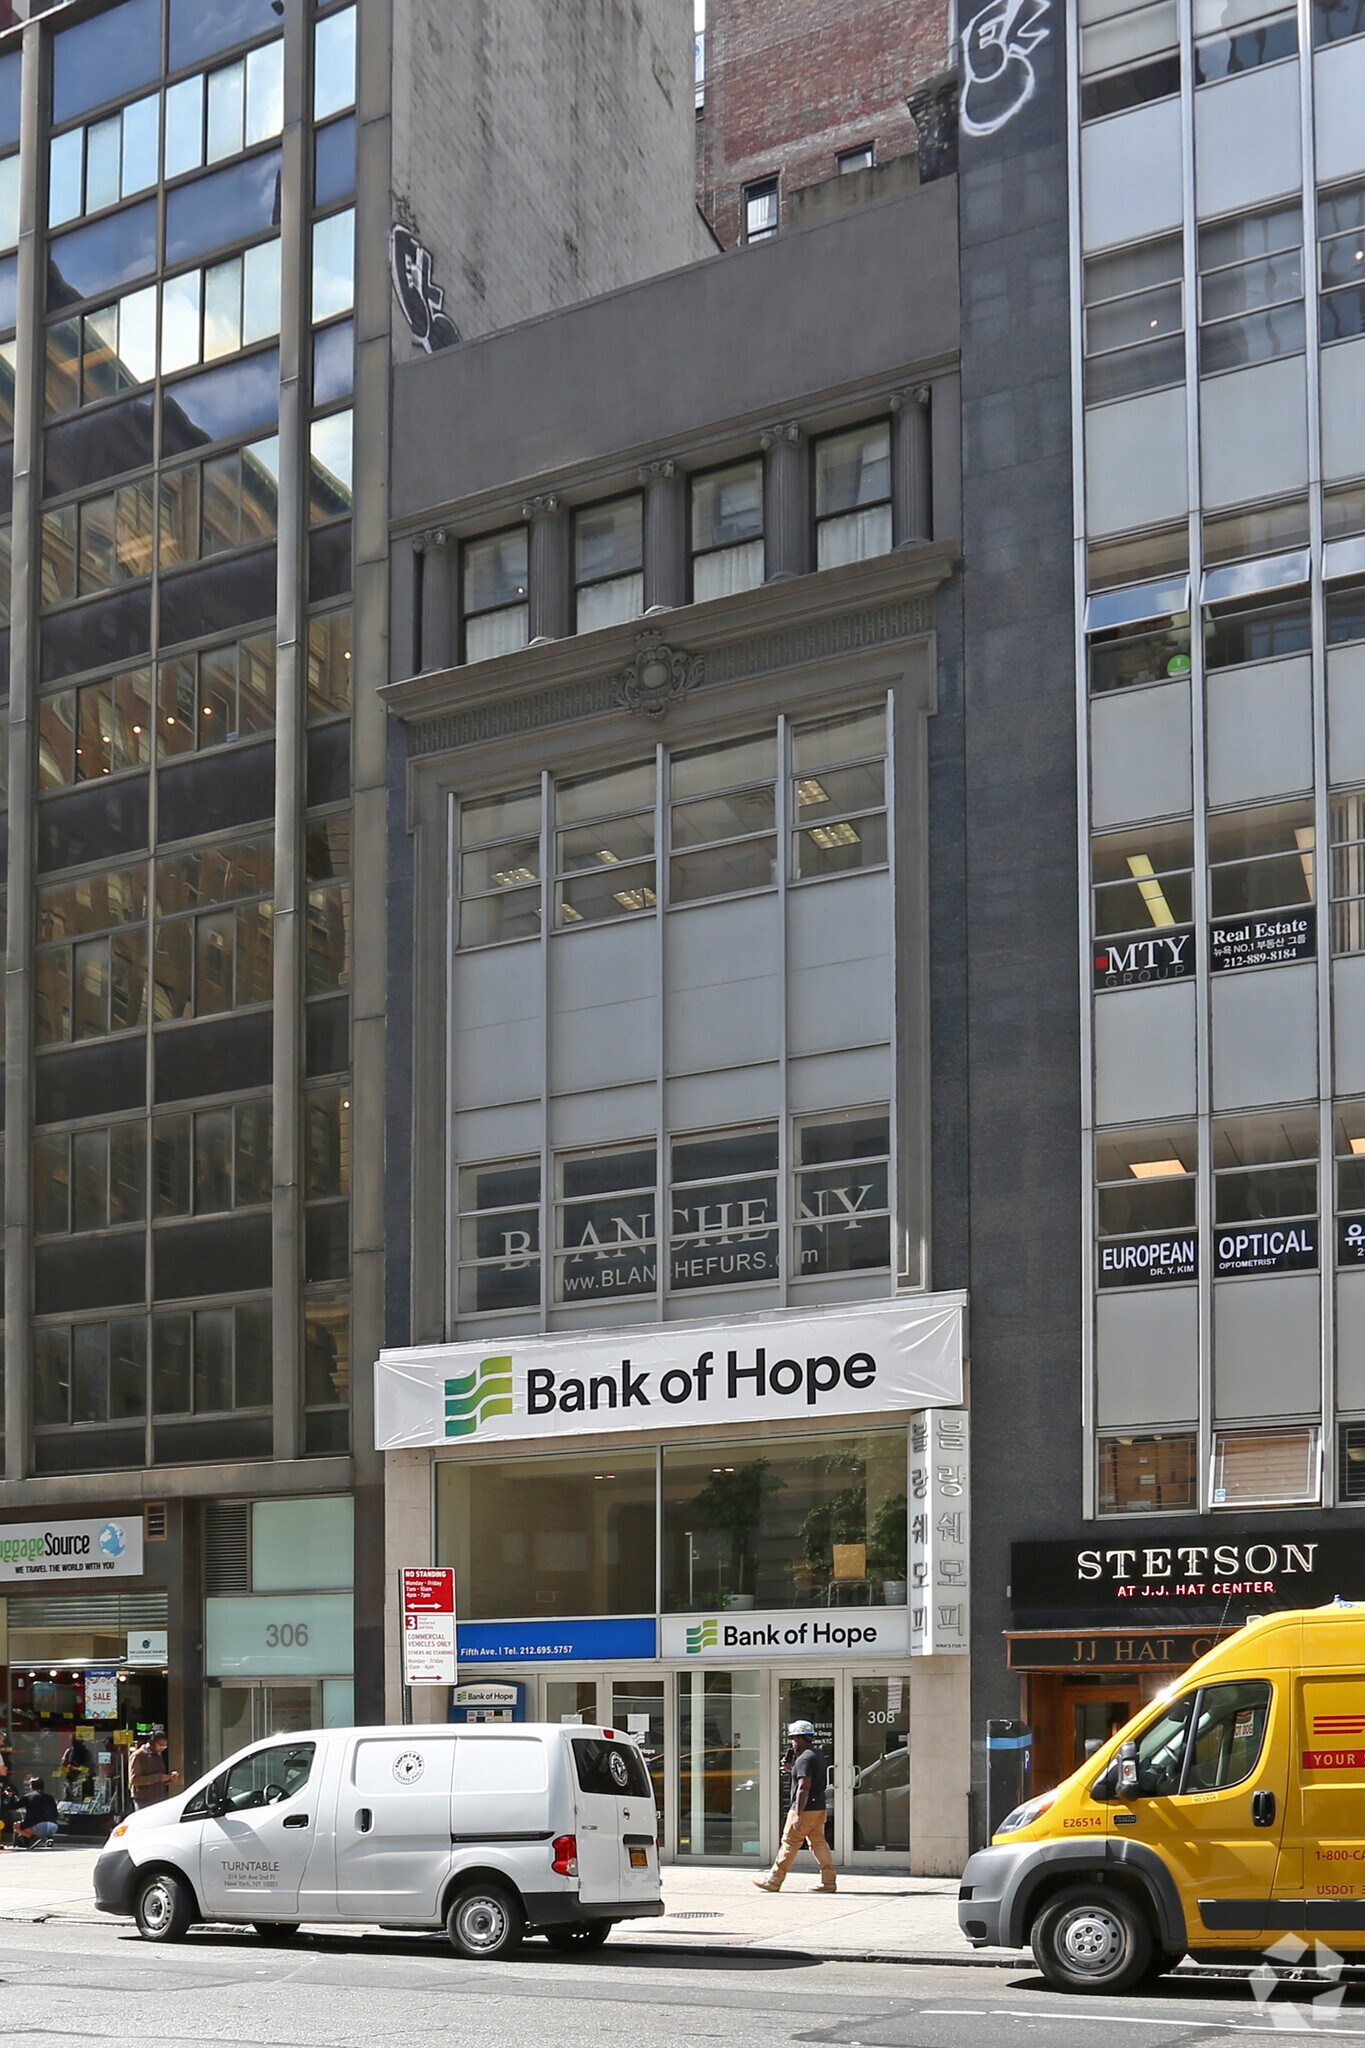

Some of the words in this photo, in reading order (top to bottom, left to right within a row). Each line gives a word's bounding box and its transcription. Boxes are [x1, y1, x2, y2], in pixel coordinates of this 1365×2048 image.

[1213, 926, 1250, 945] Real
[1255, 919, 1307, 938] Estate
[1105, 935, 1189, 974] MTY
[1233, 943, 1254, 953] NO.1
[1223, 948, 1296, 968] 212-889-8184
[1105, 964, 1185, 987] GROUP
[500, 1198, 770, 1271] BANHE
[1103, 1240, 1194, 1270] EUROPEAN
[1219, 1229, 1313, 1260] OPTICAL
[1150, 1267, 1166, 1276] DR.
[1167, 1267, 1175, 1275] Y.
[1177, 1265, 1194, 1274] KIM
[1219, 1258, 1277, 1270] OPTOMETRIST
[527, 1359, 651, 1415] Bank
[660, 1351, 713, 1404] of
[727, 1347, 876, 1405] Hope
[0, 1532, 90, 1562] ggageSource
[15, 1566, 24, 1574] WE
[25, 1565, 47, 1573] TRAVEL
[49, 1563, 60, 1572] THE
[61, 1563, 84, 1572] WORLD
[84, 1562, 101, 1570] WITH
[102, 1561, 115, 1570] YOU
[1077, 1544, 1318, 1580] STETSON
[1117, 1586, 1136, 1597] AT
[1141, 1585, 1169, 1597] J.J.
[1176, 1583, 1206, 1596] HAT
[1212, 1581, 1275, 1595] CENTER
[407, 1616, 416, 1629] 3
[266, 1623, 309, 1648] 306
[724, 1624, 780, 1646] Bank
[784, 1622, 807, 1644] of
[813, 1622, 877, 1648] Hope
[460, 1648, 479, 1656] Fifth
[480, 1648, 497, 1656] Ave.
[504, 1647, 518, 1655] Tel.
[520, 1645, 573, 1655] 212.695.5757
[1073, 1641, 1097, 1661] JJ
[1114, 1640, 1174, 1661] HAT
[92, 1692, 112, 1701] SALE
[485, 1692, 493, 1700] of
[494, 1692, 513, 1701] Hope
[867, 1711, 895, 1723] 308
[640, 1747, 656, 1755] Hope
[1313, 1753, 1356, 1766] YOUR
[1063, 1817, 1102, 1828] E26514
[220, 1861, 280, 1871] TURNTABLE
[1316, 1885, 1354, 1895] USDOT
